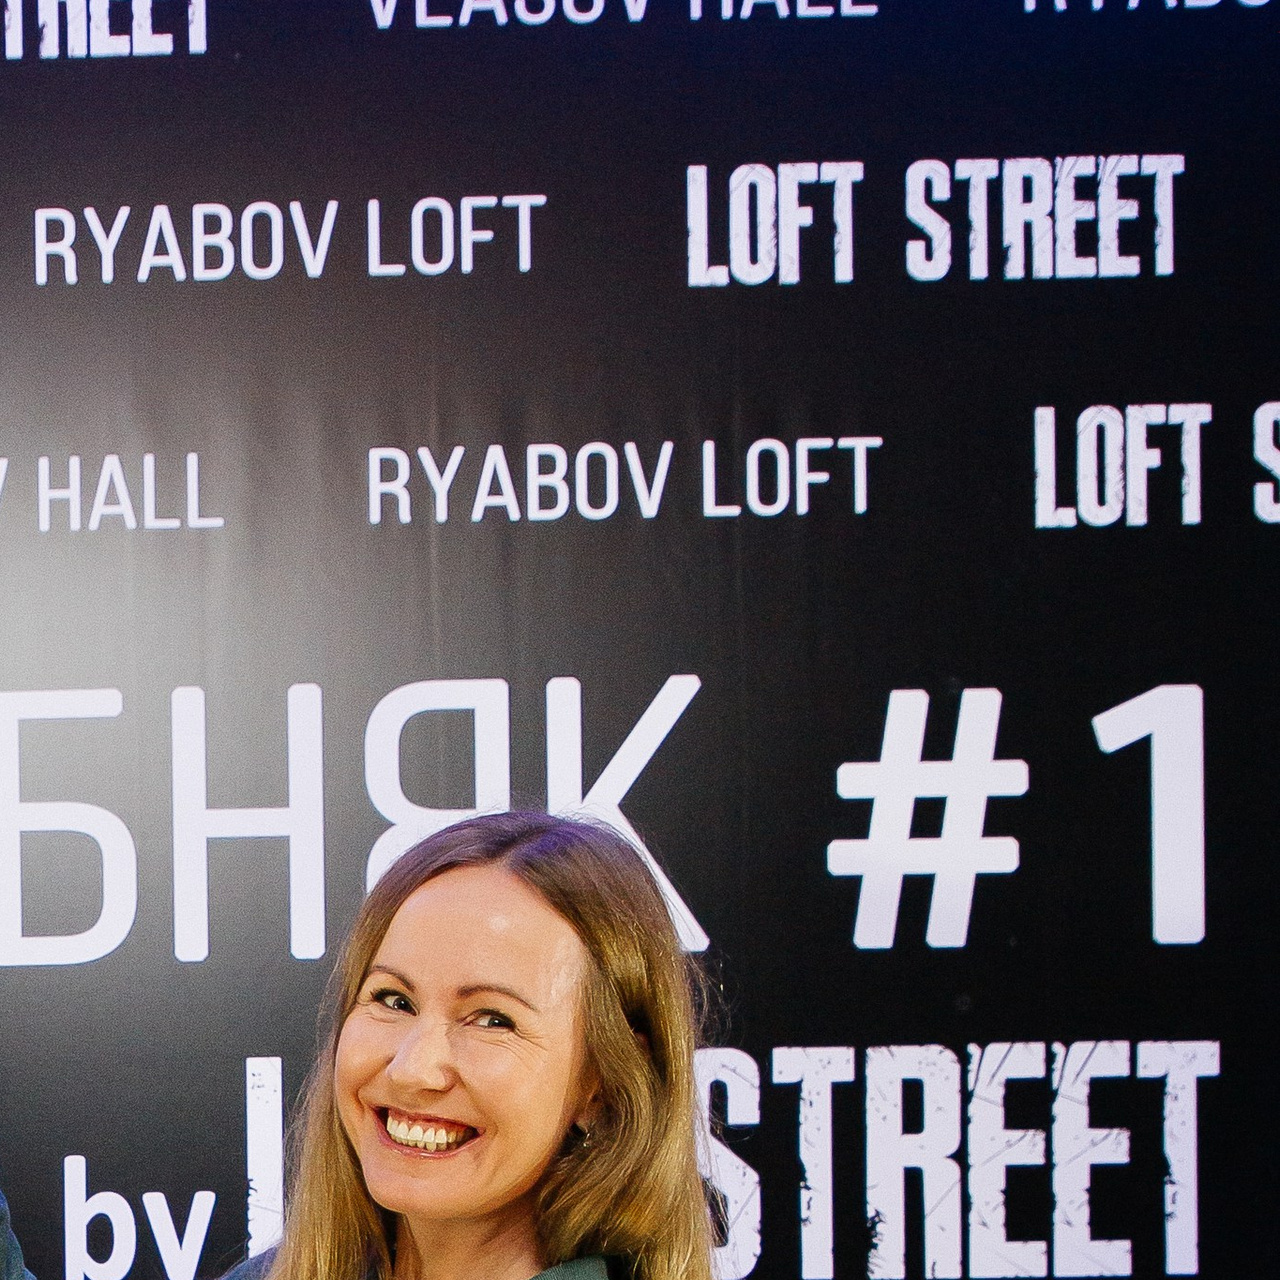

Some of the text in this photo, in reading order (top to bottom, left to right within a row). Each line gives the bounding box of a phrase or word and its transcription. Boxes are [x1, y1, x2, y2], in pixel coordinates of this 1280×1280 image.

[34, 194, 548, 287] RYABOV LOFT
[686, 154, 1185, 288] LOFT STREET
[38, 453, 224, 531] HALL
[367, 436, 883, 526] RYABOV LOFT
[1033, 402, 1213, 529] LOFT
